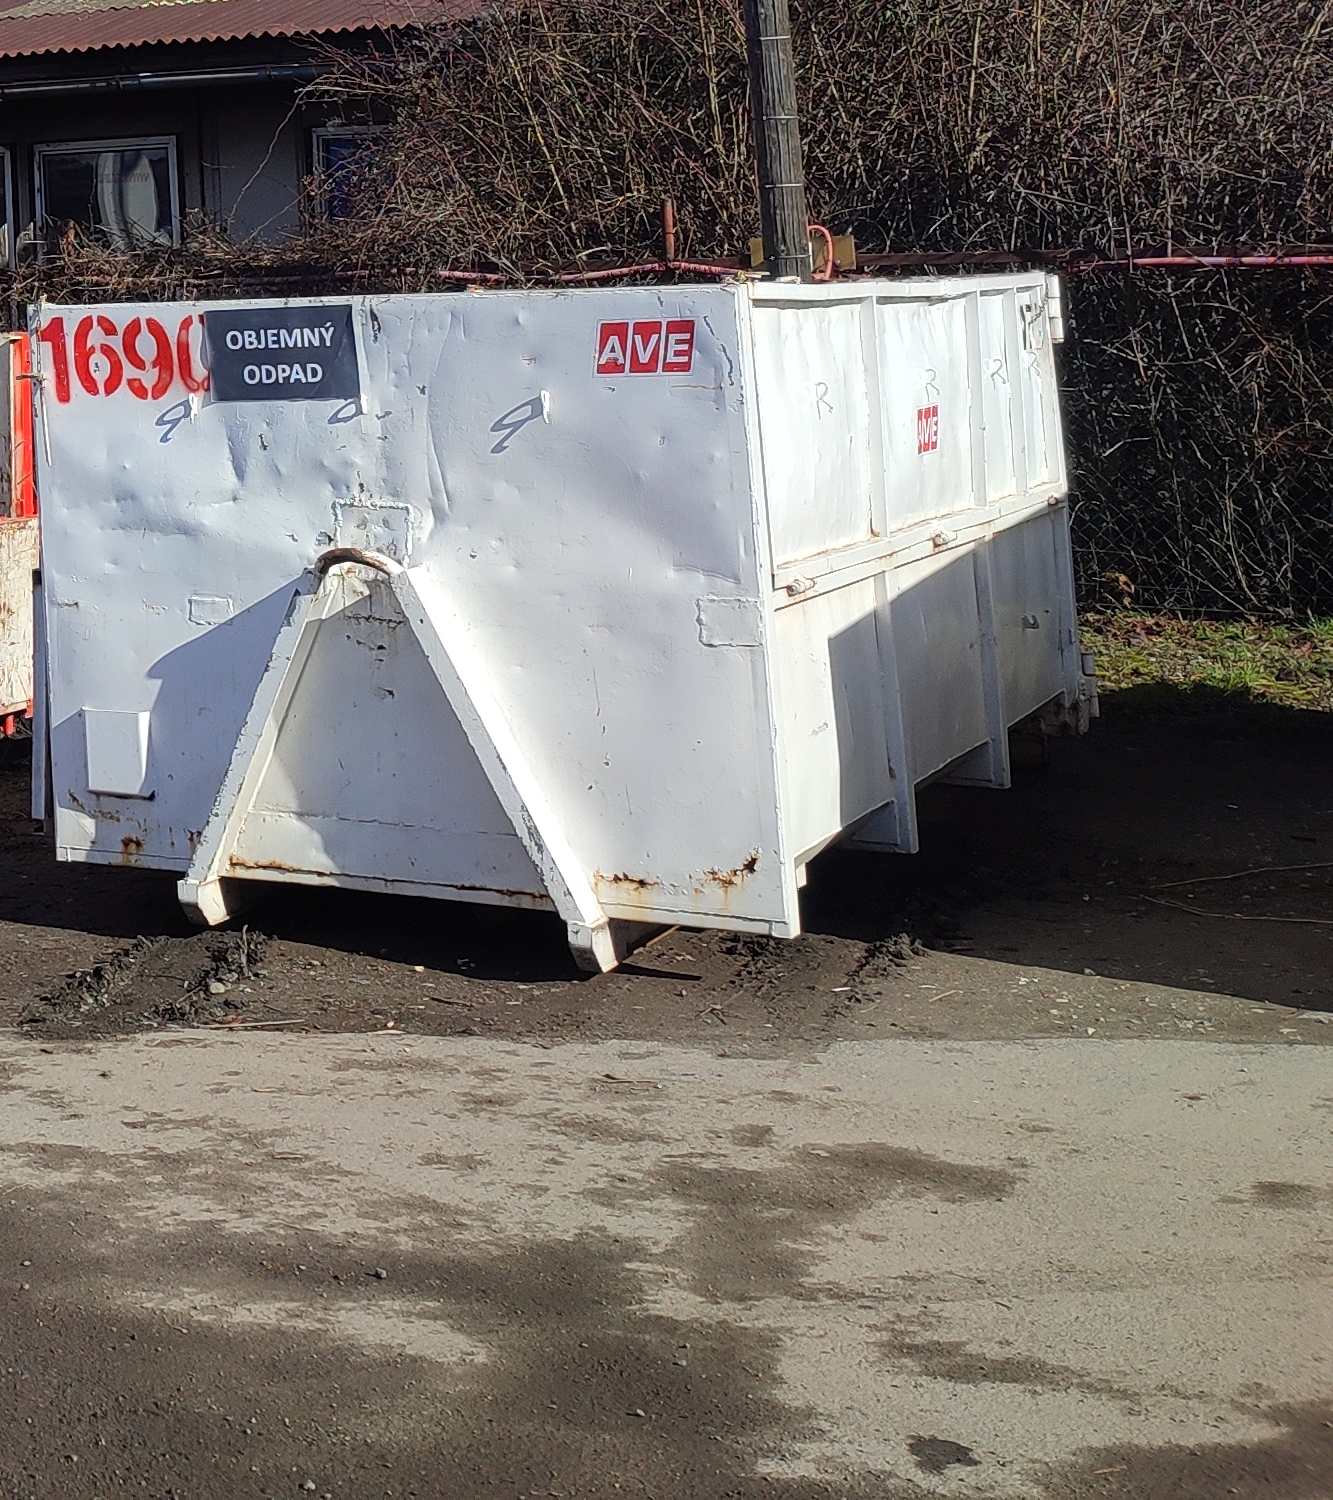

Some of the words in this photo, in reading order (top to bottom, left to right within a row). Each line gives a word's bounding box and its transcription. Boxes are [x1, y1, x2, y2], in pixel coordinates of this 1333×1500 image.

[225, 321, 335, 350] OBJEMNÝ
[598, 332, 691, 365] AVE
[243, 363, 323, 385] ODPAD
